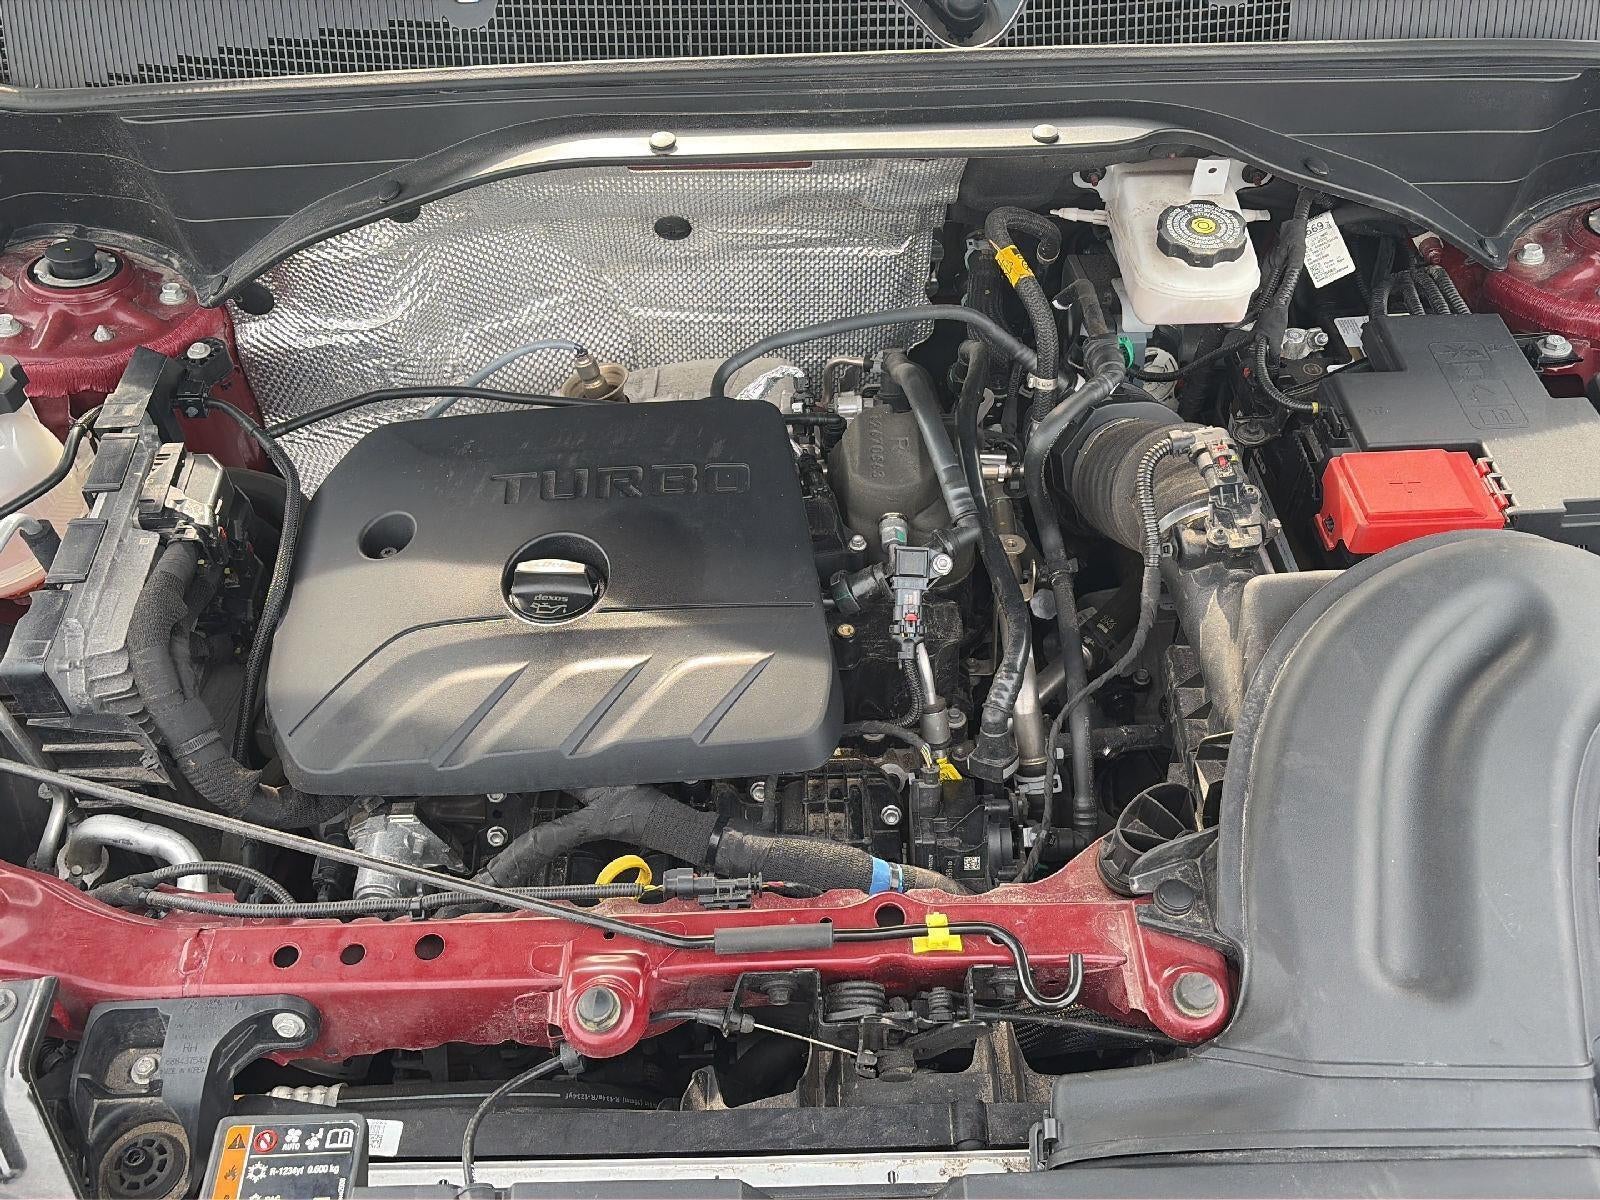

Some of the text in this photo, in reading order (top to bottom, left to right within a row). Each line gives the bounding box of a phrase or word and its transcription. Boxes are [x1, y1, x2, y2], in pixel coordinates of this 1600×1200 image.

[490, 463, 751, 504] TURBO
[533, 593, 569, 602] dexos
[281, 1142, 300, 1151] AUTO
[269, 1165, 305, 1176] R-1234yf
[329, 1163, 340, 1175] kg
